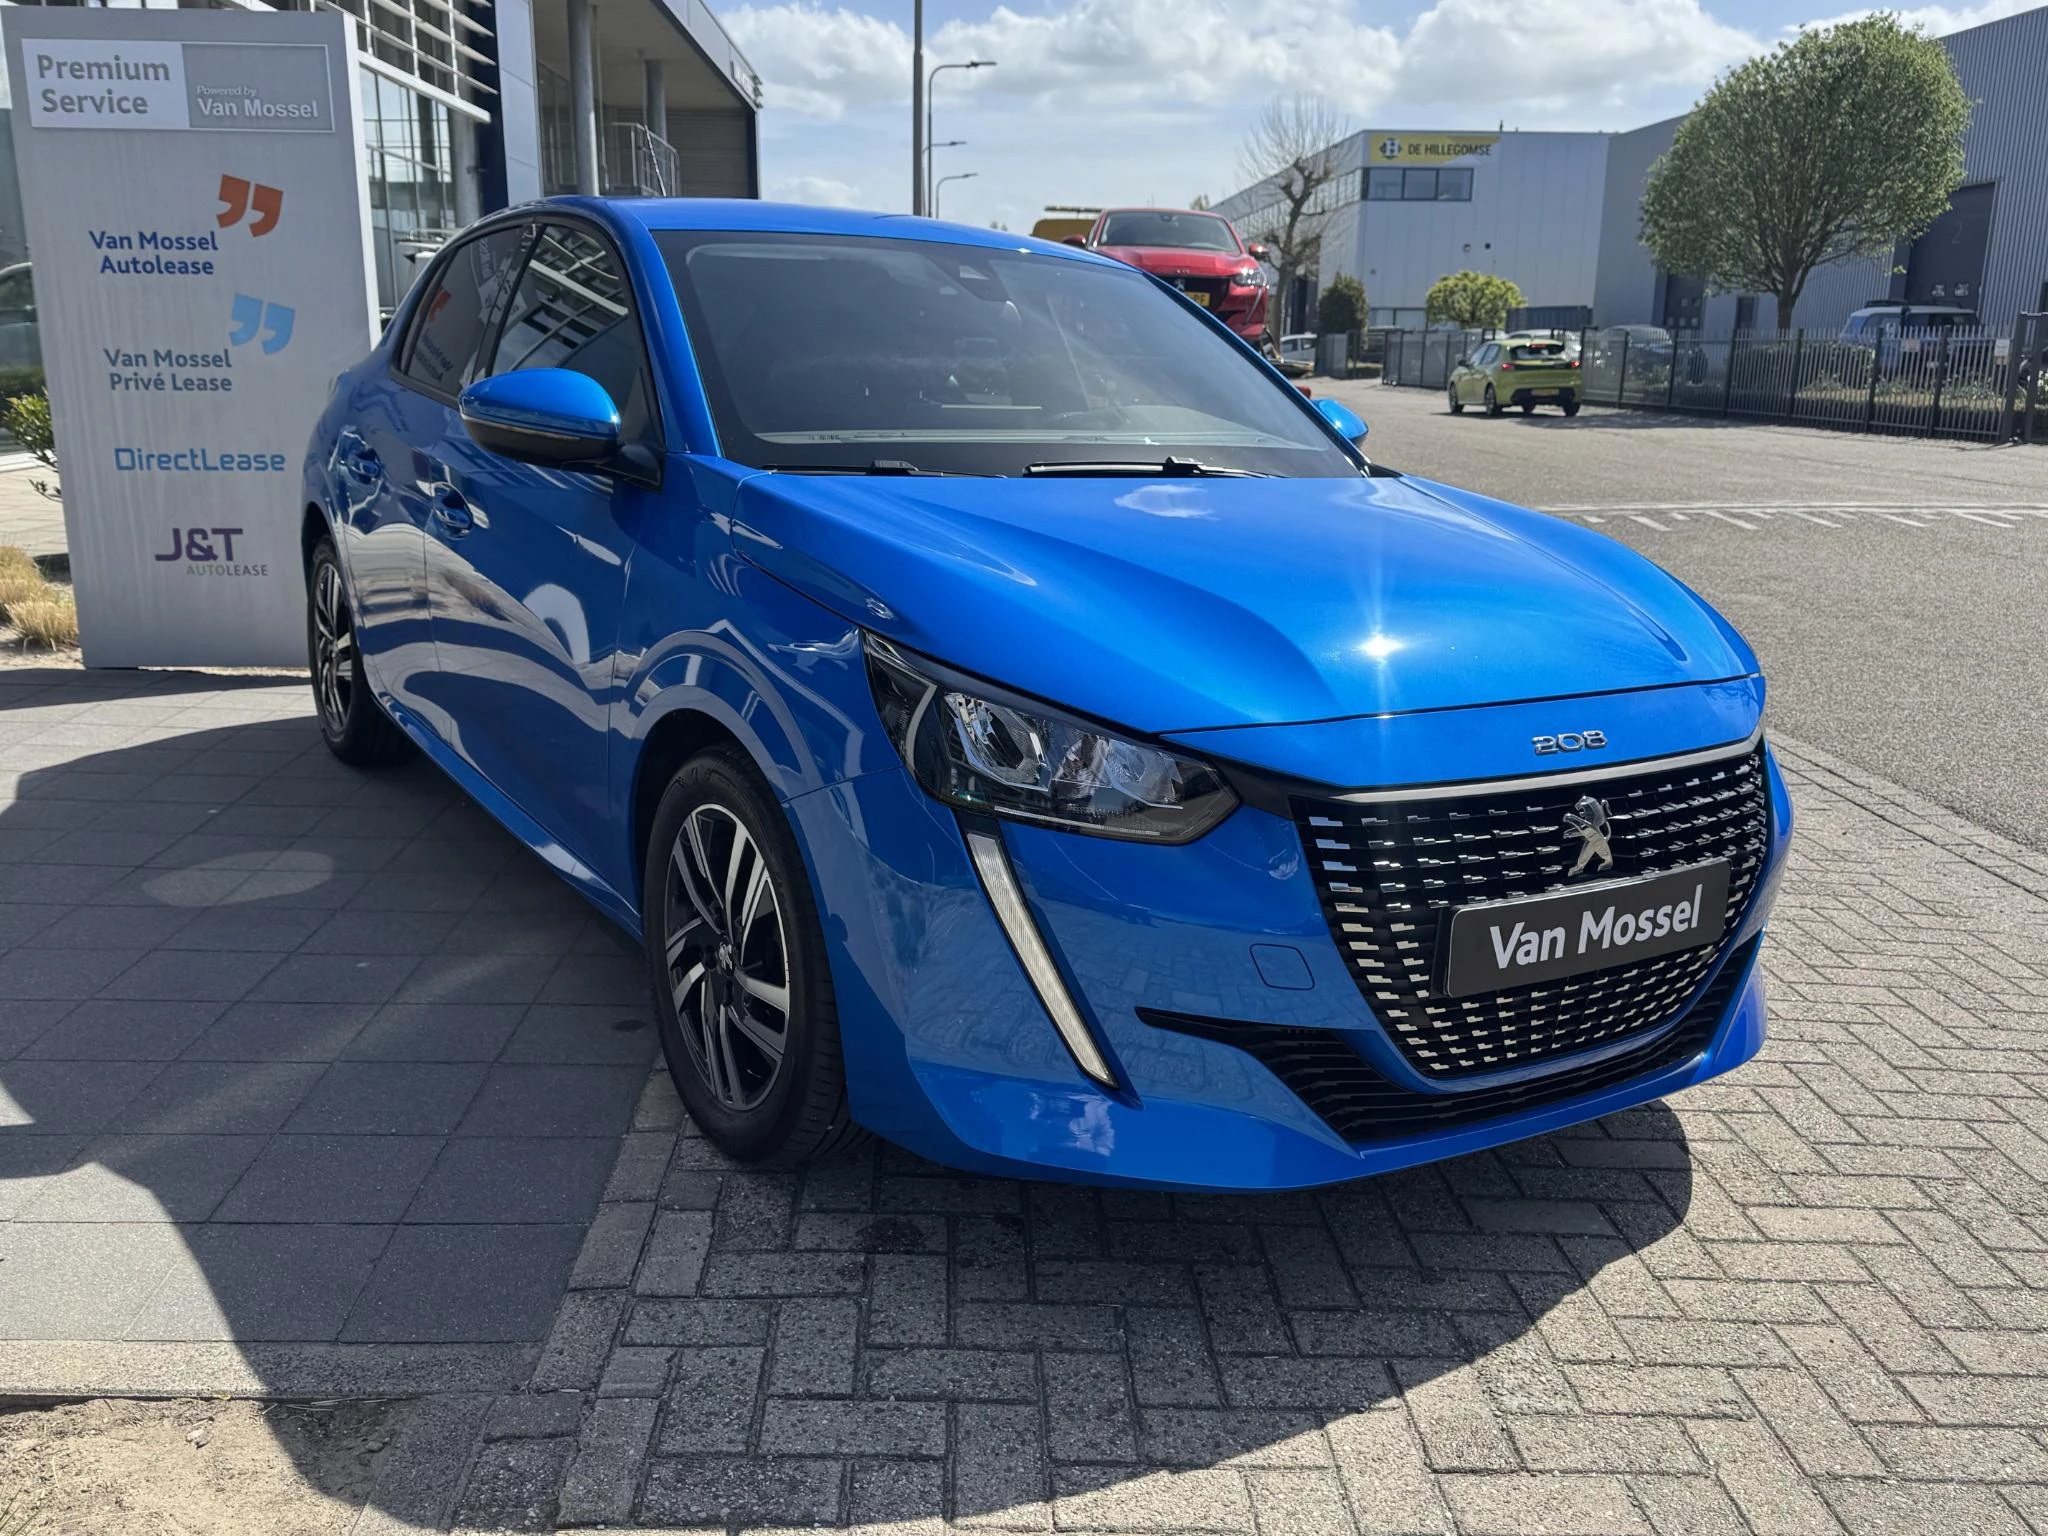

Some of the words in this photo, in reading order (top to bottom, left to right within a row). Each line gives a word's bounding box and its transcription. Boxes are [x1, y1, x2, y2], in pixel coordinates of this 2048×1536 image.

[37, 55, 171, 81] Premium
[196, 85, 242, 96] Powered
[243, 86, 257, 97] by
[41, 89, 149, 114] Service
[198, 98, 238, 116] Van
[243, 99, 319, 118] Mossel
[1408, 144, 1422, 155] DE
[1424, 143, 1492, 156] HILLEGOMSE
[89, 230, 133, 249] Van
[138, 231, 219, 251] Mossel
[100, 256, 215, 275] Autolease
[103, 349, 148, 368] Van
[153, 350, 232, 368] Mossel
[110, 373, 165, 391] Privé
[172, 374, 233, 392] Lease
[115, 448, 286, 472] DirectLease
[154, 527, 244, 562] J&T
[186, 564, 269, 577] AUTOLEASE
[1531, 730, 1609, 756] 208
[1489, 921, 1566, 970] Van
[1577, 883, 1704, 955] Mossel
